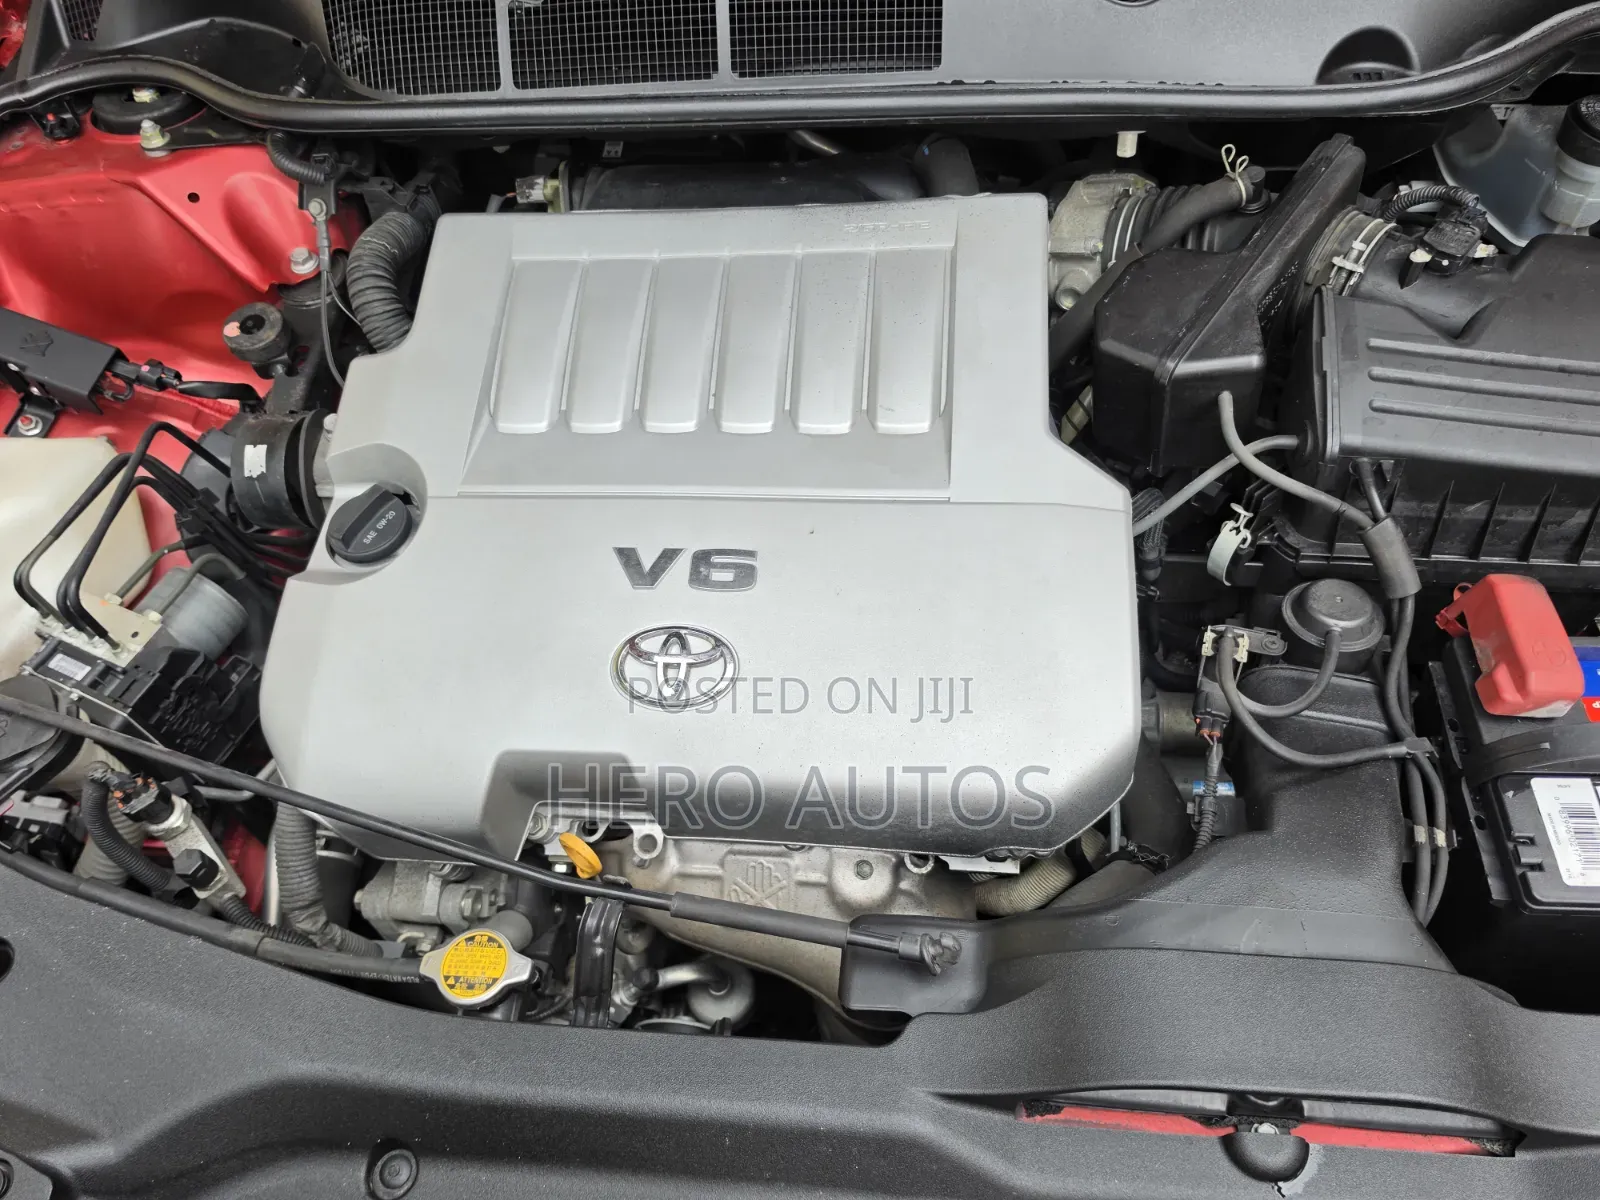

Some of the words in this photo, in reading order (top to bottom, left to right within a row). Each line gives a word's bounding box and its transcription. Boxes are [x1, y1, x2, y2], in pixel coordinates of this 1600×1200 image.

[363, 530, 378, 544] SAE
[376, 510, 396, 529] 0W-20
[612, 547, 758, 592] V6
[458, 976, 493, 985] ATTENTION
